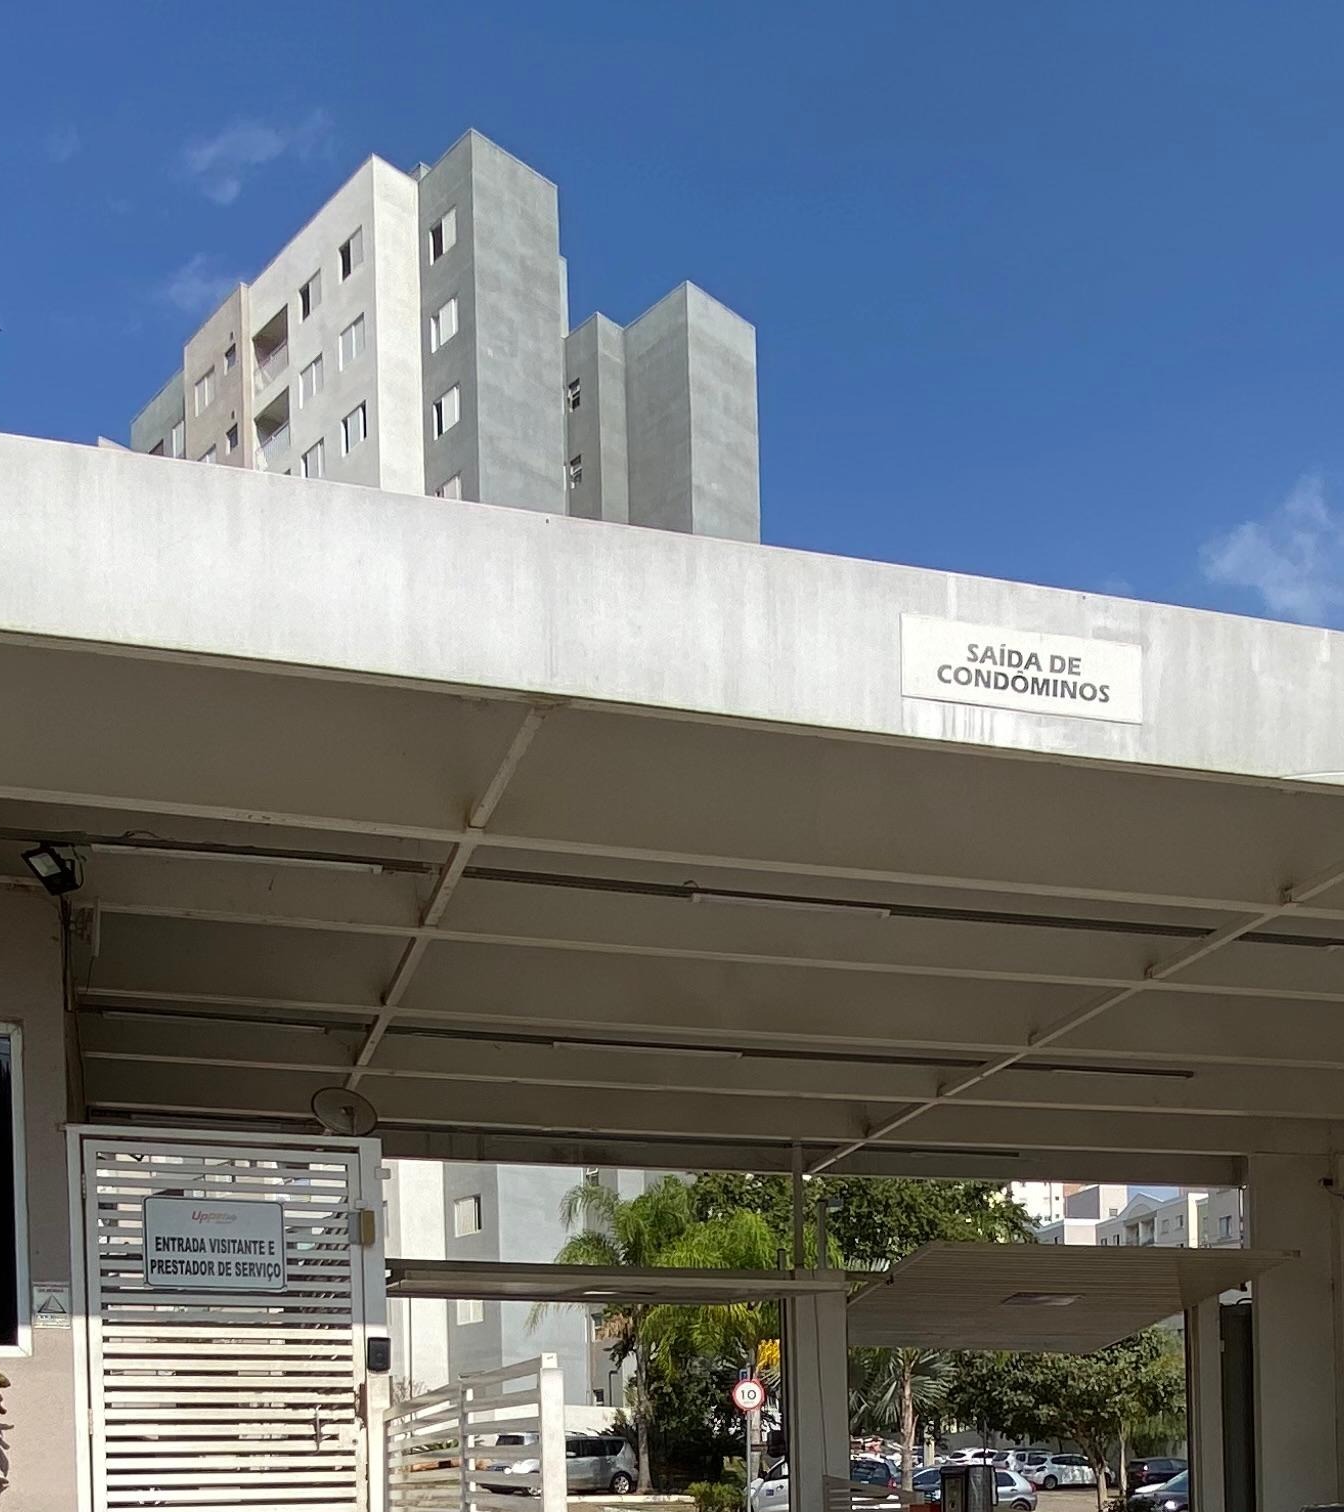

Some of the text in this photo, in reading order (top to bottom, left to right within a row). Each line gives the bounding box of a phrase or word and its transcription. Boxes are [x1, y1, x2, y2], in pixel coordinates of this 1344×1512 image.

[966, 643, 1082, 677] SAÍDA DE
[937, 664, 1111, 703] CONDÔMINOS
[155, 1236, 275, 1256] ENTRADA VISITANTE E
[150, 1259, 281, 1281] PRESTADOR DE SERVIÇO
[740, 1389, 757, 1401] 10
